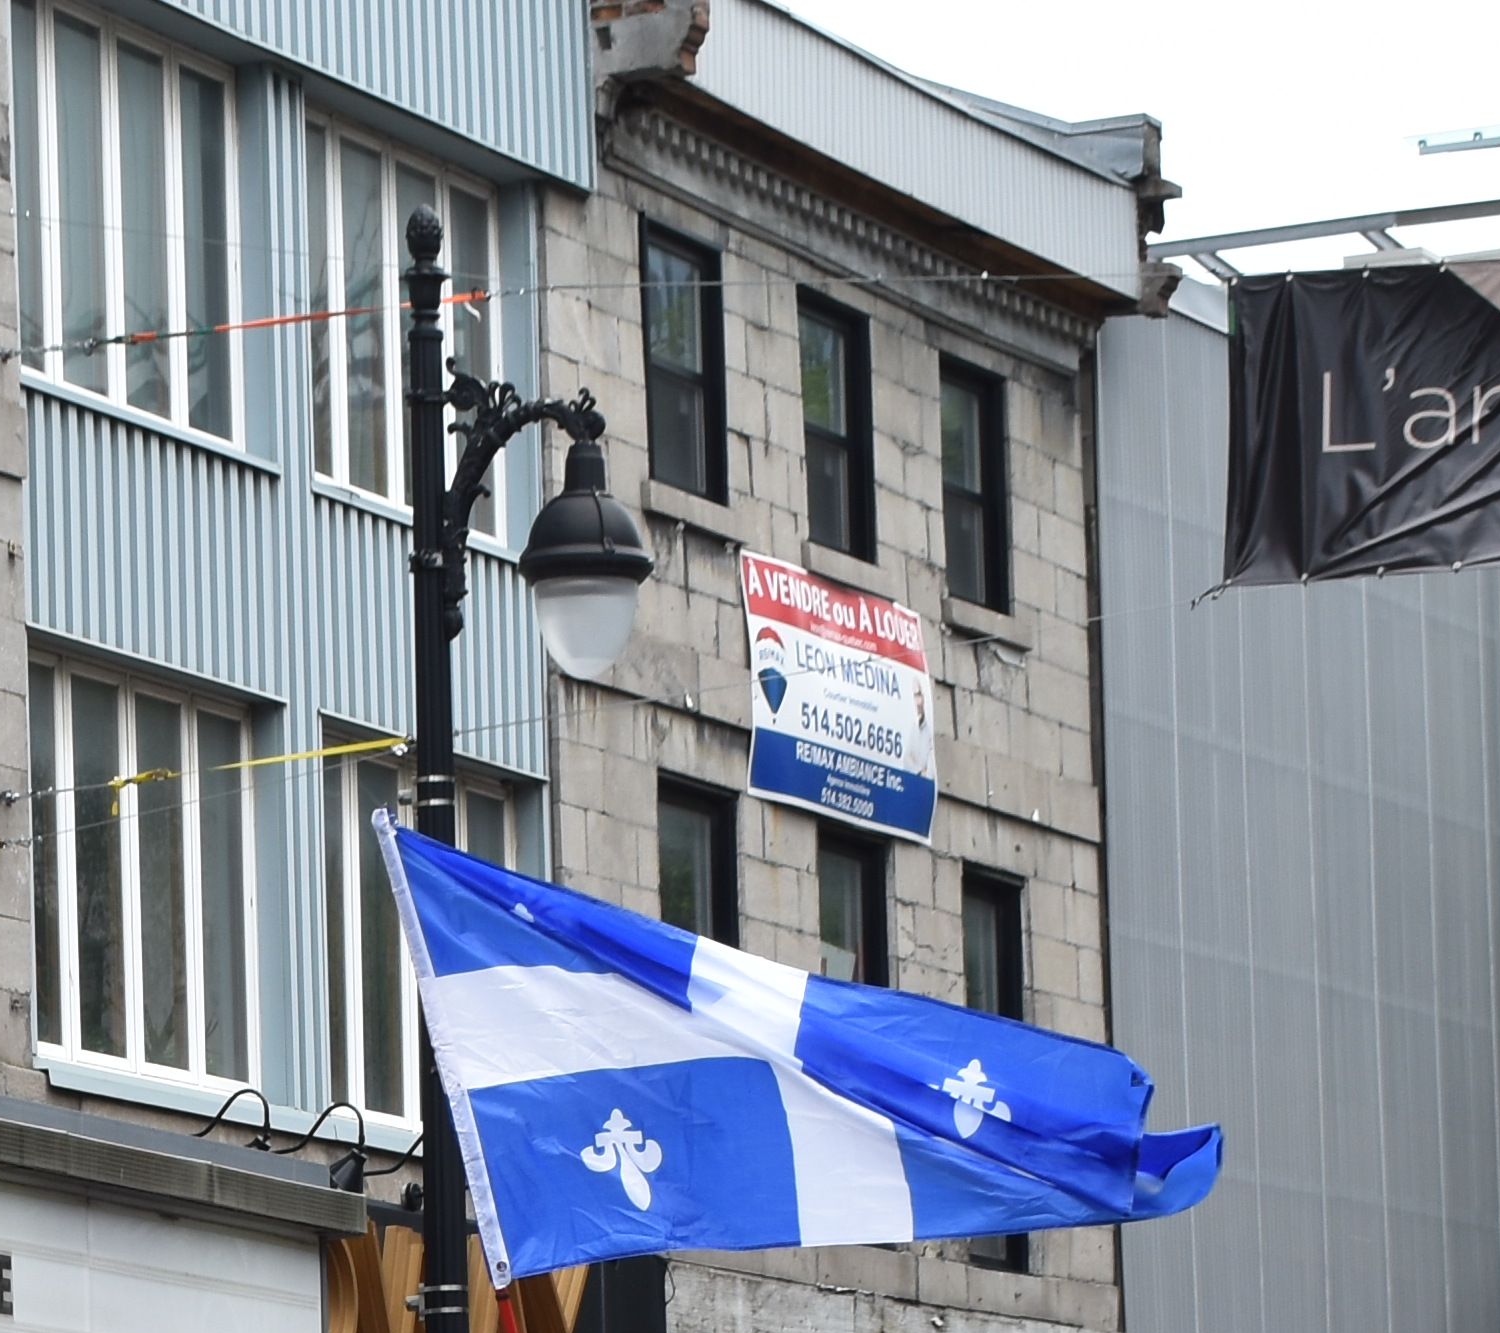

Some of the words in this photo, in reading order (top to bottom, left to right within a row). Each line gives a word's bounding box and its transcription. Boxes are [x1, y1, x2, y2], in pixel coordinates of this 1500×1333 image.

[748, 558, 763, 598] À
[765, 569, 830, 619] VENDRE
[833, 601, 855, 630] ou
[858, 597, 873, 634] À
[874, 608, 919, 651] LOUER
[795, 641, 838, 681] LEON
[841, 657, 902, 700] MEDINA
[800, 703, 903, 759] 514.502.6656
[834, 752, 885, 787] AMBIANCE
[886, 773, 904, 792] inc.
